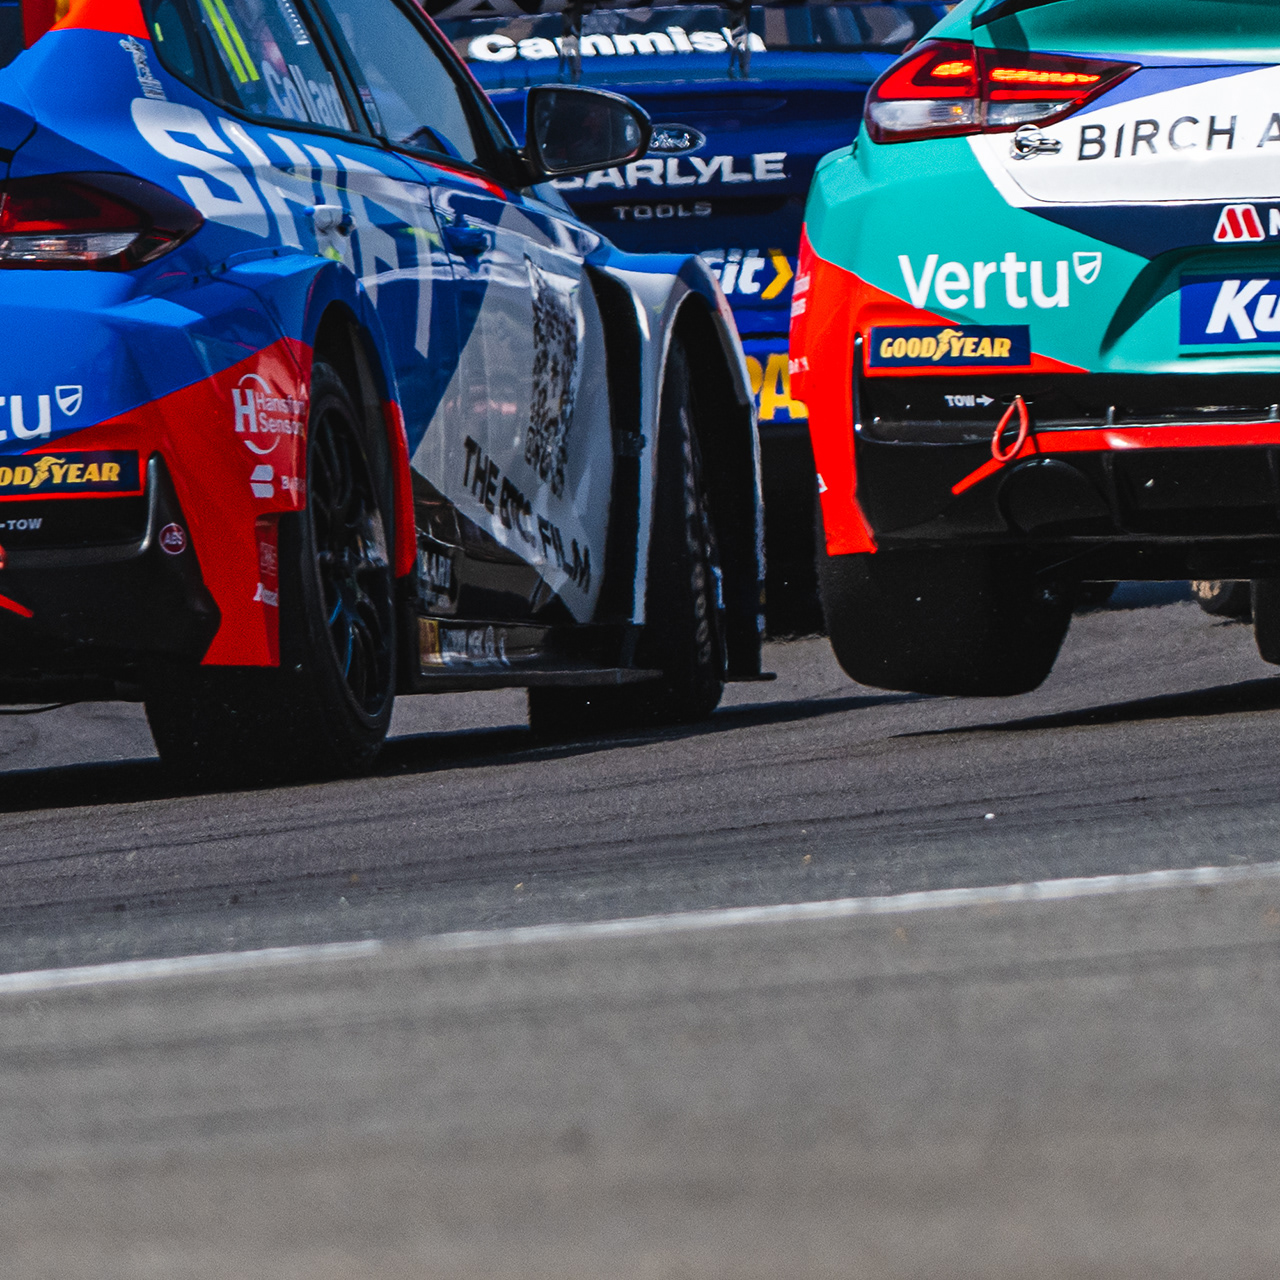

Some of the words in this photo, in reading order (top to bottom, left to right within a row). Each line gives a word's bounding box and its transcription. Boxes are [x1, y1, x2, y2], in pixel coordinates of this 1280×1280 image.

[1078, 114, 1234, 161] BIRCH
[614, 201, 712, 220] TOOLS
[898, 252, 1069, 309] Vertu
[945, 394, 974, 407] TOW
[7, 517, 42, 531] TOW
